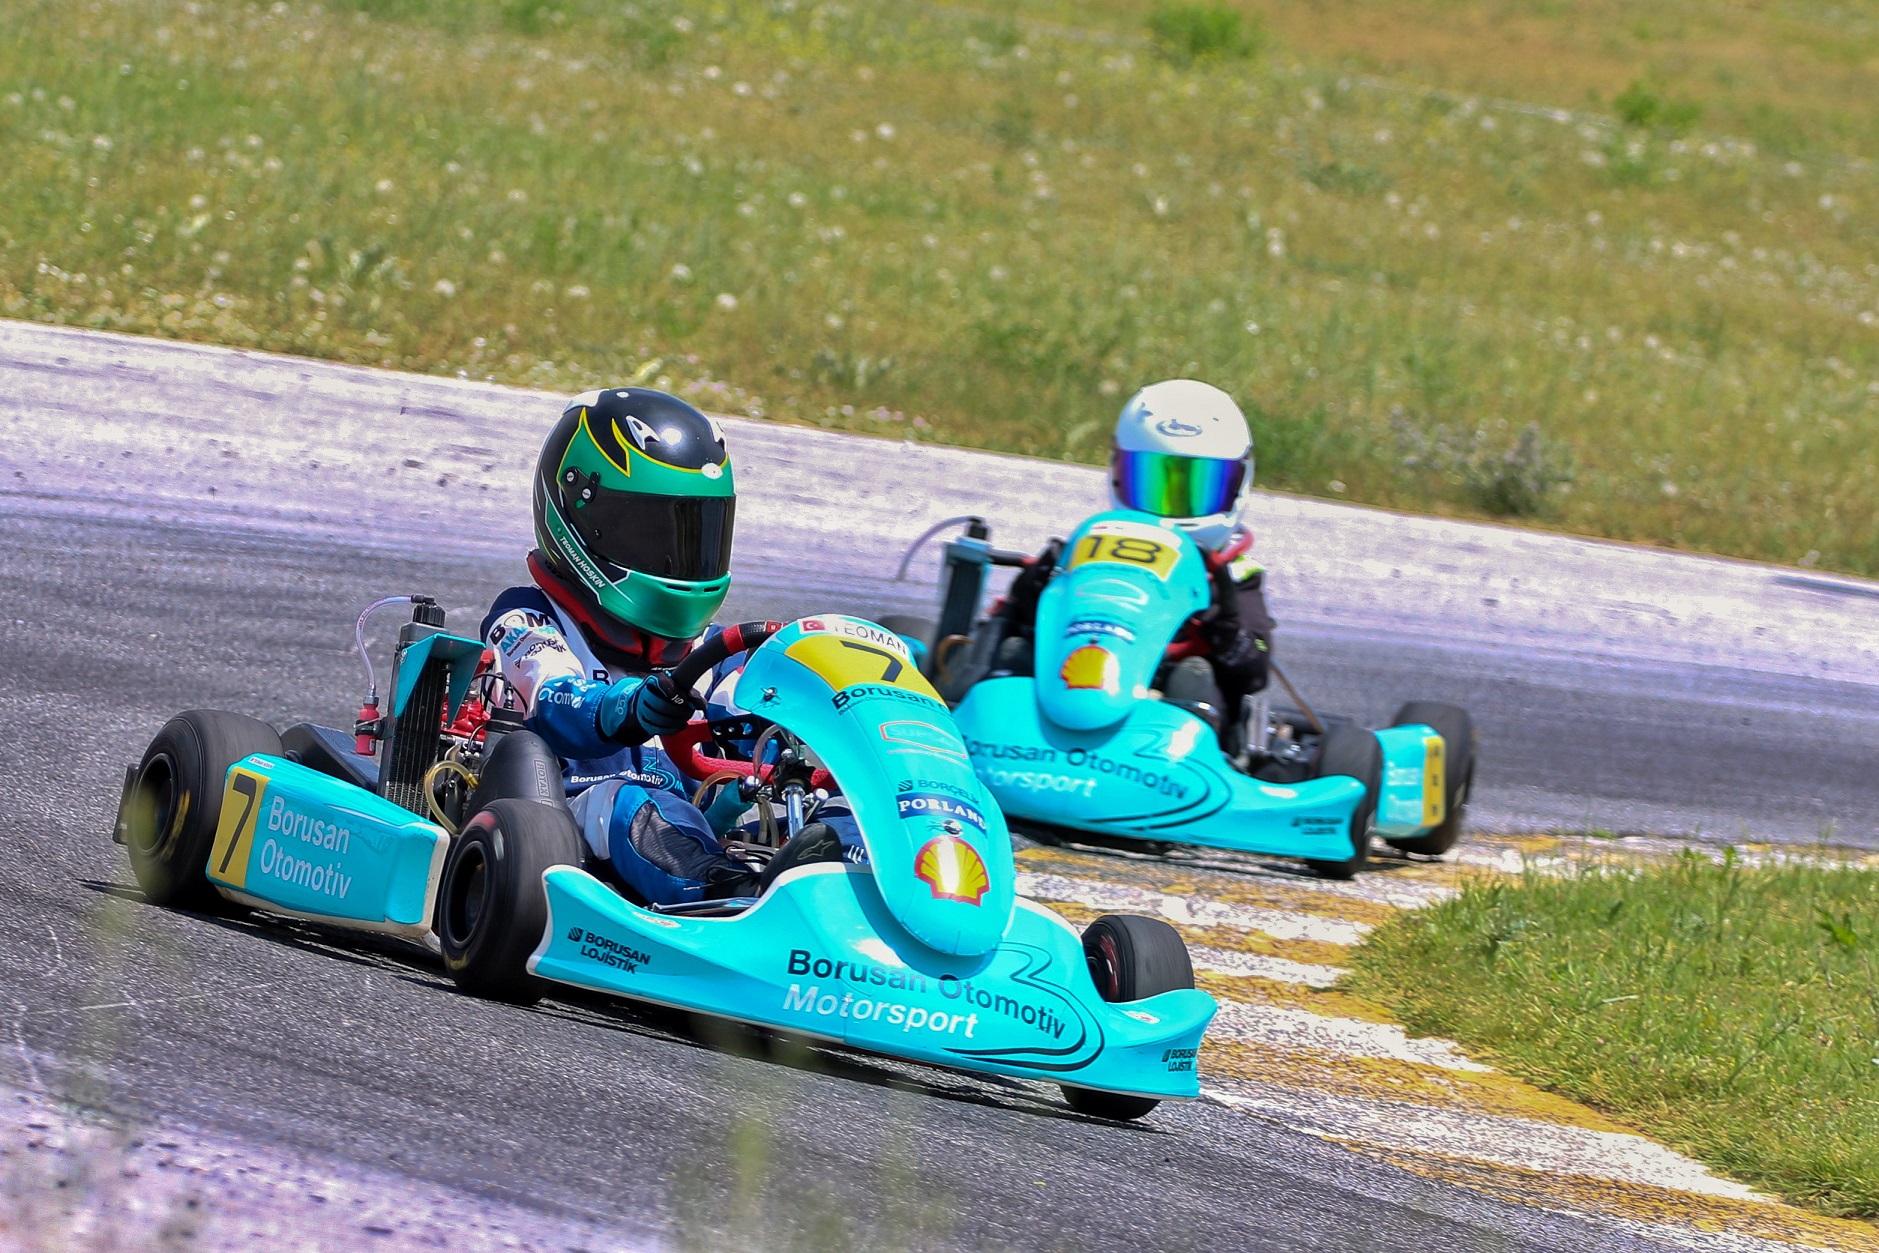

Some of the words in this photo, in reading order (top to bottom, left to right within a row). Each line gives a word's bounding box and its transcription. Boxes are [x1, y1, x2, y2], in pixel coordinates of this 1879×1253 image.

[560, 536, 581, 562] TEOMAN
[577, 561, 606, 588] HOSKIN
[1088, 536, 1162, 564] 18
[839, 640, 903, 684] 7
[831, 687, 935, 709] Borusan
[964, 738, 1056, 763] orusan
[219, 773, 257, 874] 7
[267, 796, 351, 854] Borusan
[899, 798, 987, 830] PORLAND
[260, 839, 352, 899] Otomotiv
[581, 945, 638, 974] LOJİSTİK
[585, 932, 651, 965] BORUSAN
[782, 984, 979, 1040] Motorsport
[787, 950, 926, 994] Borusan
[938, 974, 1066, 1040] Otomotiv
